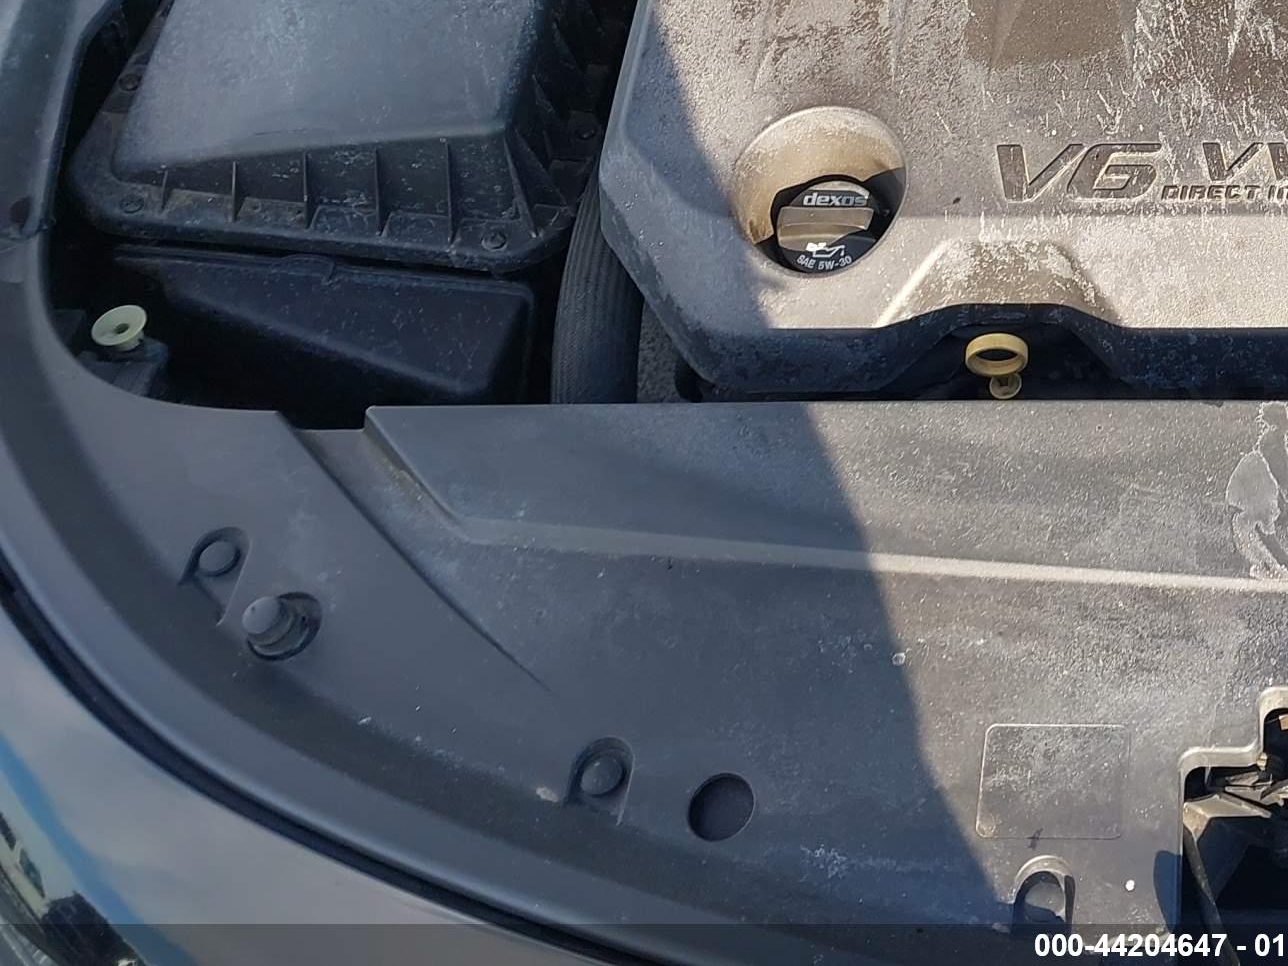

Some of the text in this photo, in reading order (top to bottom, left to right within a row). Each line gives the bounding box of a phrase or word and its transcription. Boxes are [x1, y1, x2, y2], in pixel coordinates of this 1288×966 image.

[996, 143, 1163, 202] V6
[802, 192, 868, 207] dexos
[1161, 184, 1257, 202] DIRECT
[796, 255, 853, 271] SAE 5W-30
